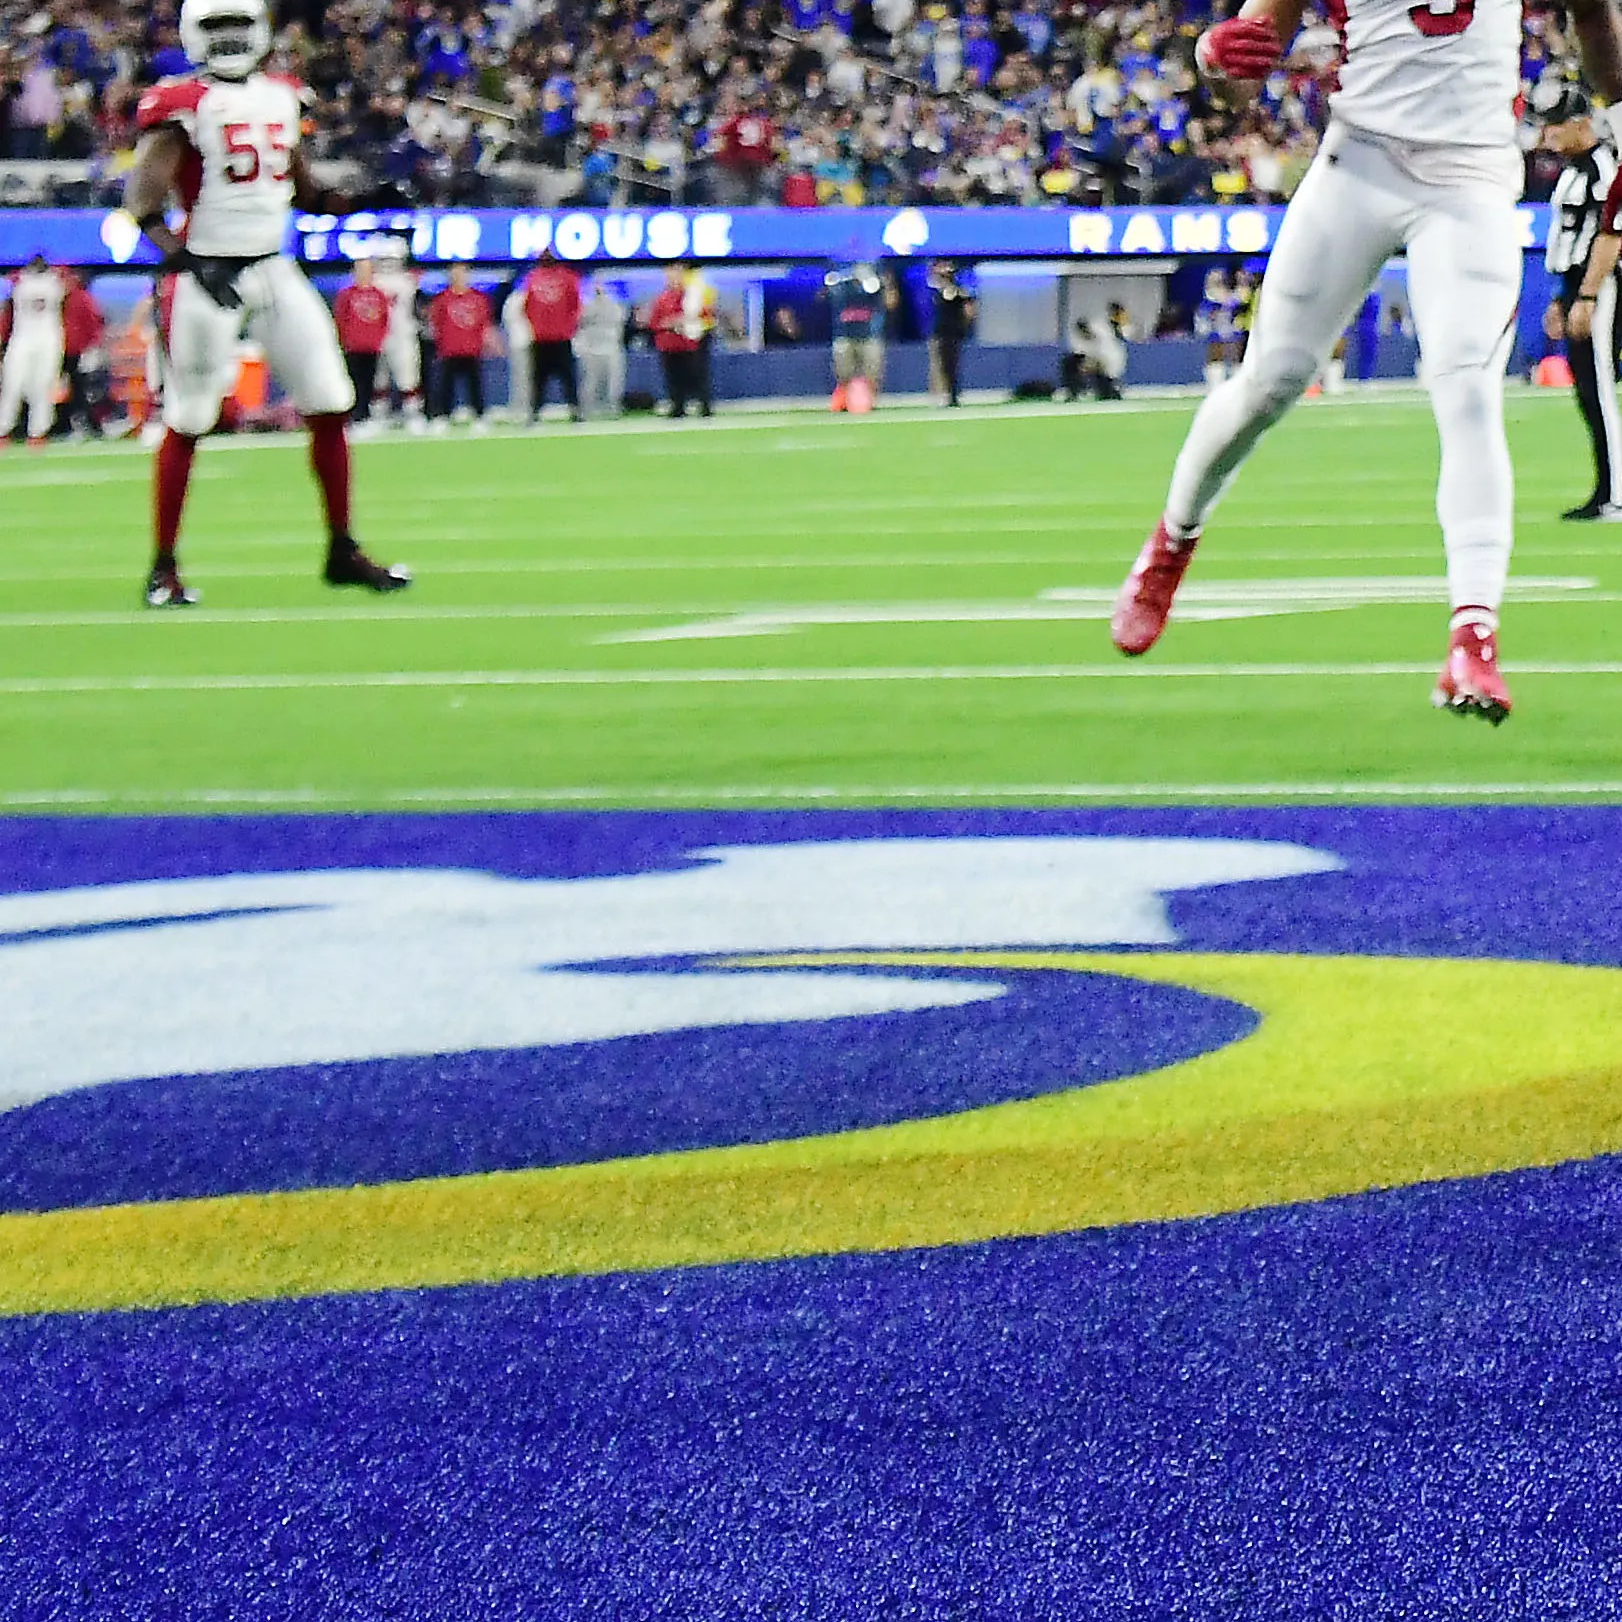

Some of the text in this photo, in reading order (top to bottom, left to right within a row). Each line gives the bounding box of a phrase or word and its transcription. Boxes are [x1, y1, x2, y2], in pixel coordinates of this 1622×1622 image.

[222, 124, 288, 184] 55
[510, 213, 732, 260] HOUSE
[1069, 212, 1269, 254] RAMS
